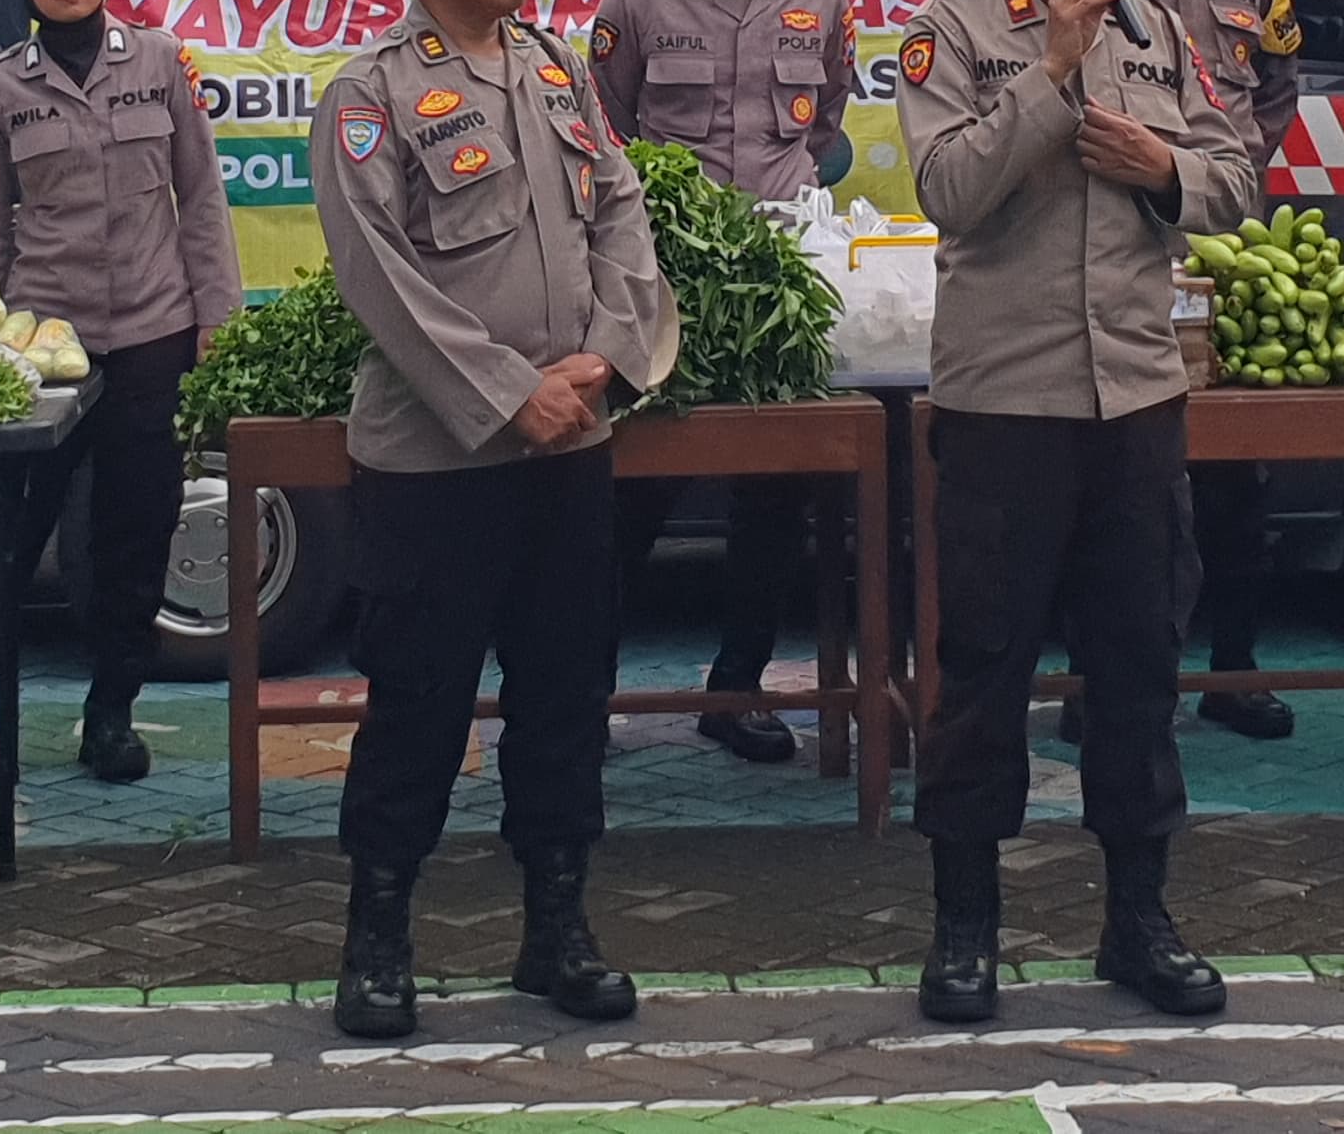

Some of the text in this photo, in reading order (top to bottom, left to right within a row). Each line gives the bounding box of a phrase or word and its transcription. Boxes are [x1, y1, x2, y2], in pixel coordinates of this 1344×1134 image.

[655, 35, 707, 52] SAIFUL
[10, 87, 166, 129] AVILA POLRI
[200, 78, 316, 118] OBIL
[544, 94, 582, 112] POL
